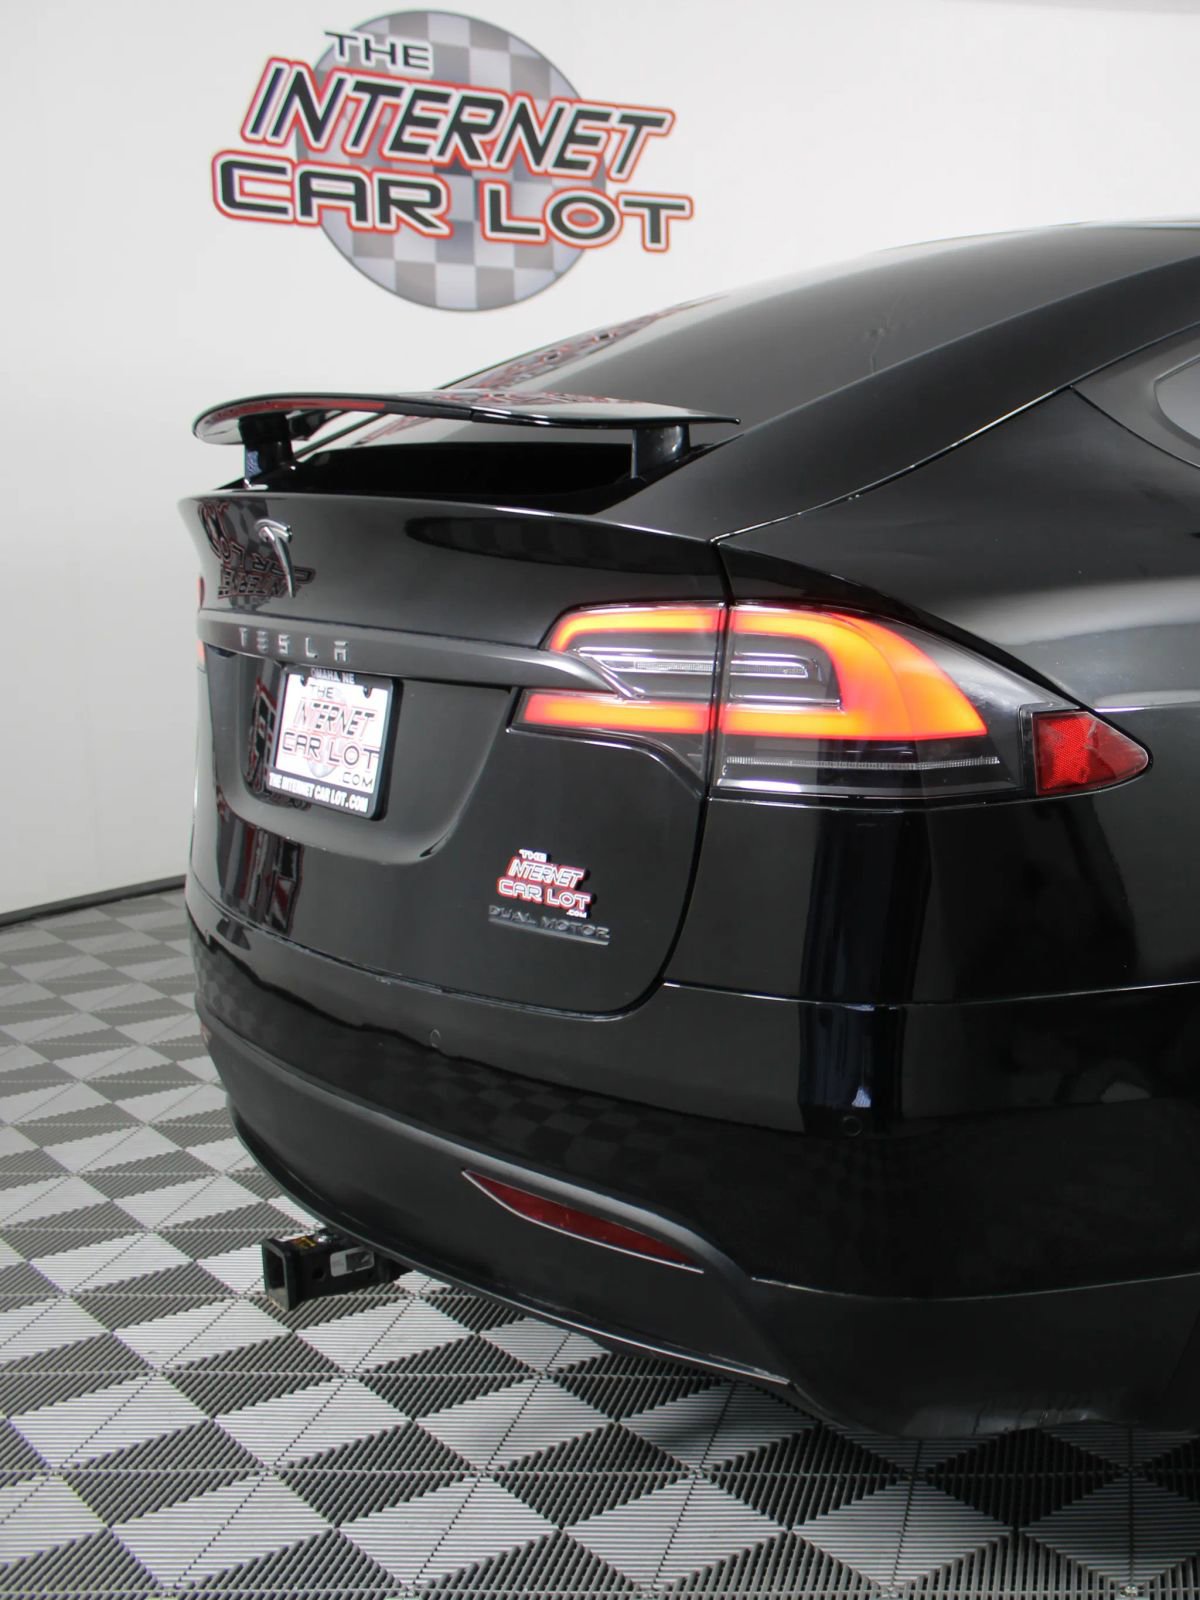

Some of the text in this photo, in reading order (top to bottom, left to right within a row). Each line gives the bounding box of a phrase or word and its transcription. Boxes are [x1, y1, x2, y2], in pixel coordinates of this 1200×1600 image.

[323, 30, 434, 72] THE
[243, 57, 673, 181] INTERNET
[214, 152, 692, 252] CAR LOT
[238, 626, 349, 663] TESLA
[309, 683, 334, 700] THE
[341, 672, 356, 685] NE
[282, 730, 380, 772] CAR LOT
[269, 772, 283, 788] THE
[314, 785, 331, 802] CAR
[519, 848, 547, 862] THE
[506, 857, 586, 889] INTERNET
[498, 878, 592, 911] CAR LOT
[487, 904, 610, 939] DUAL MOTOR
